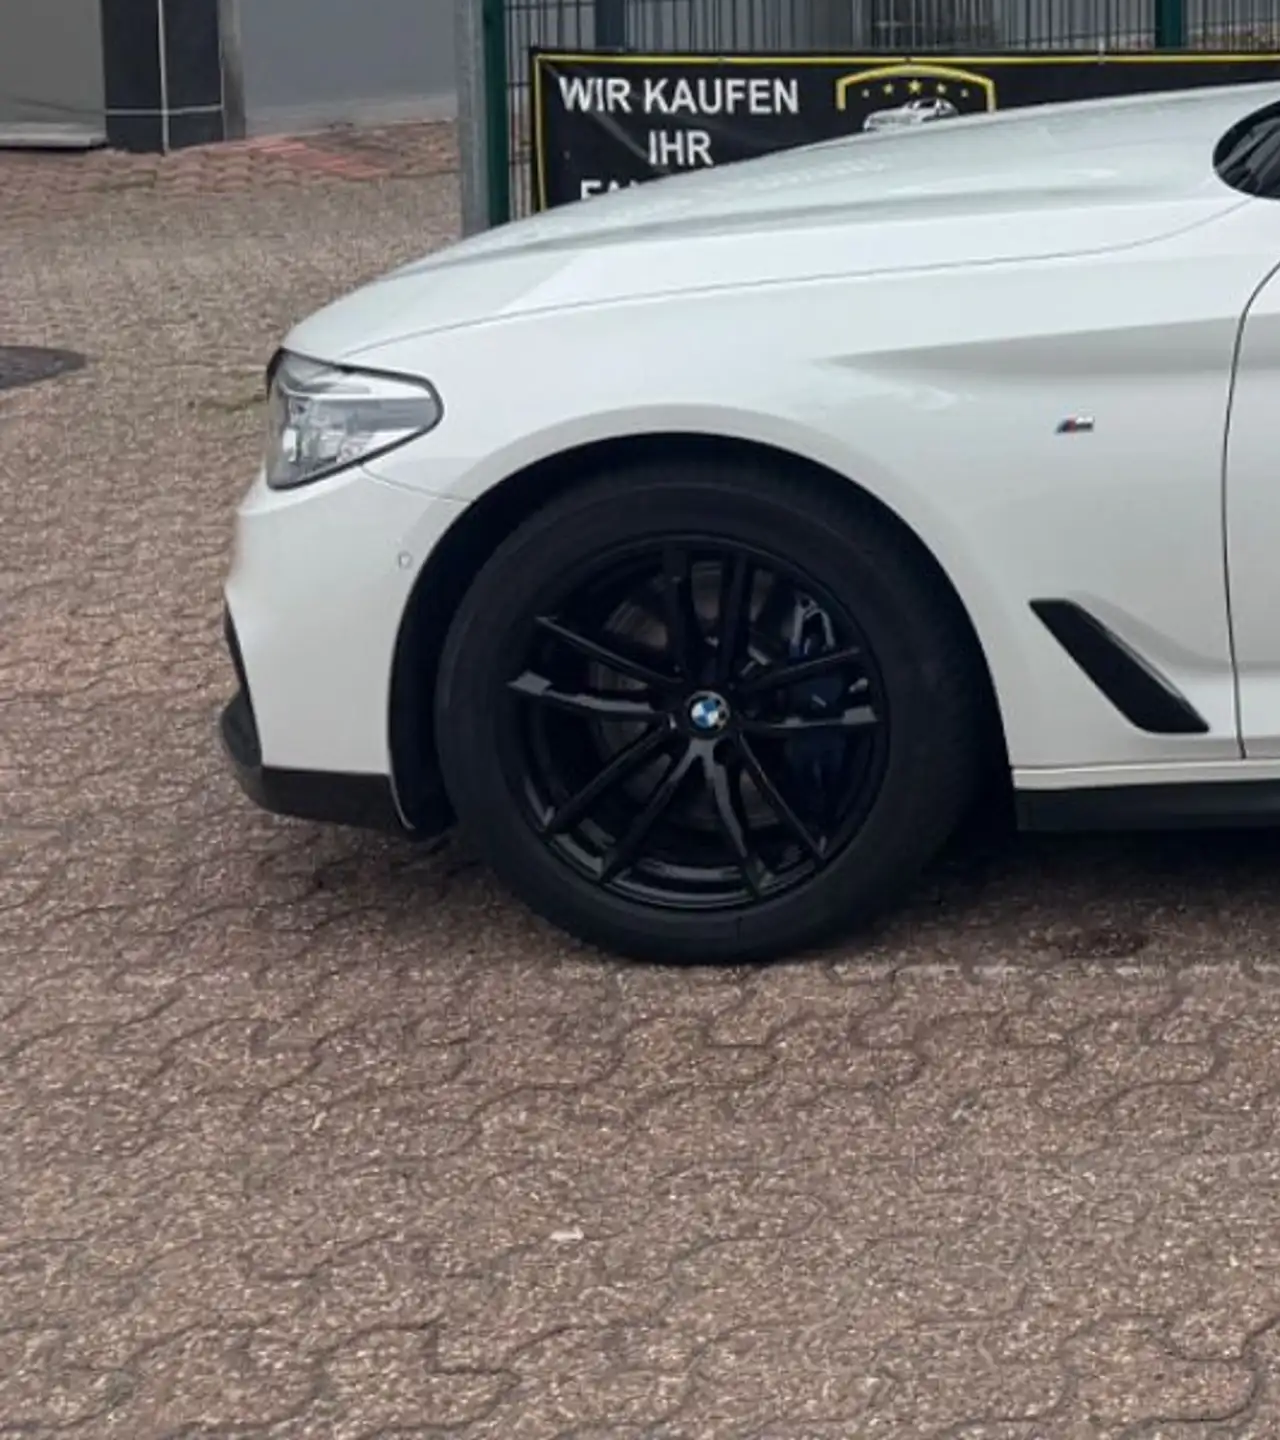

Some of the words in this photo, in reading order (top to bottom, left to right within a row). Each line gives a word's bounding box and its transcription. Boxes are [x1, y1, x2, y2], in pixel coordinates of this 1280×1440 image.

[558, 76, 632, 114] WIR
[643, 78, 799, 115] KAUFEN
[649, 130, 713, 167] IHR
